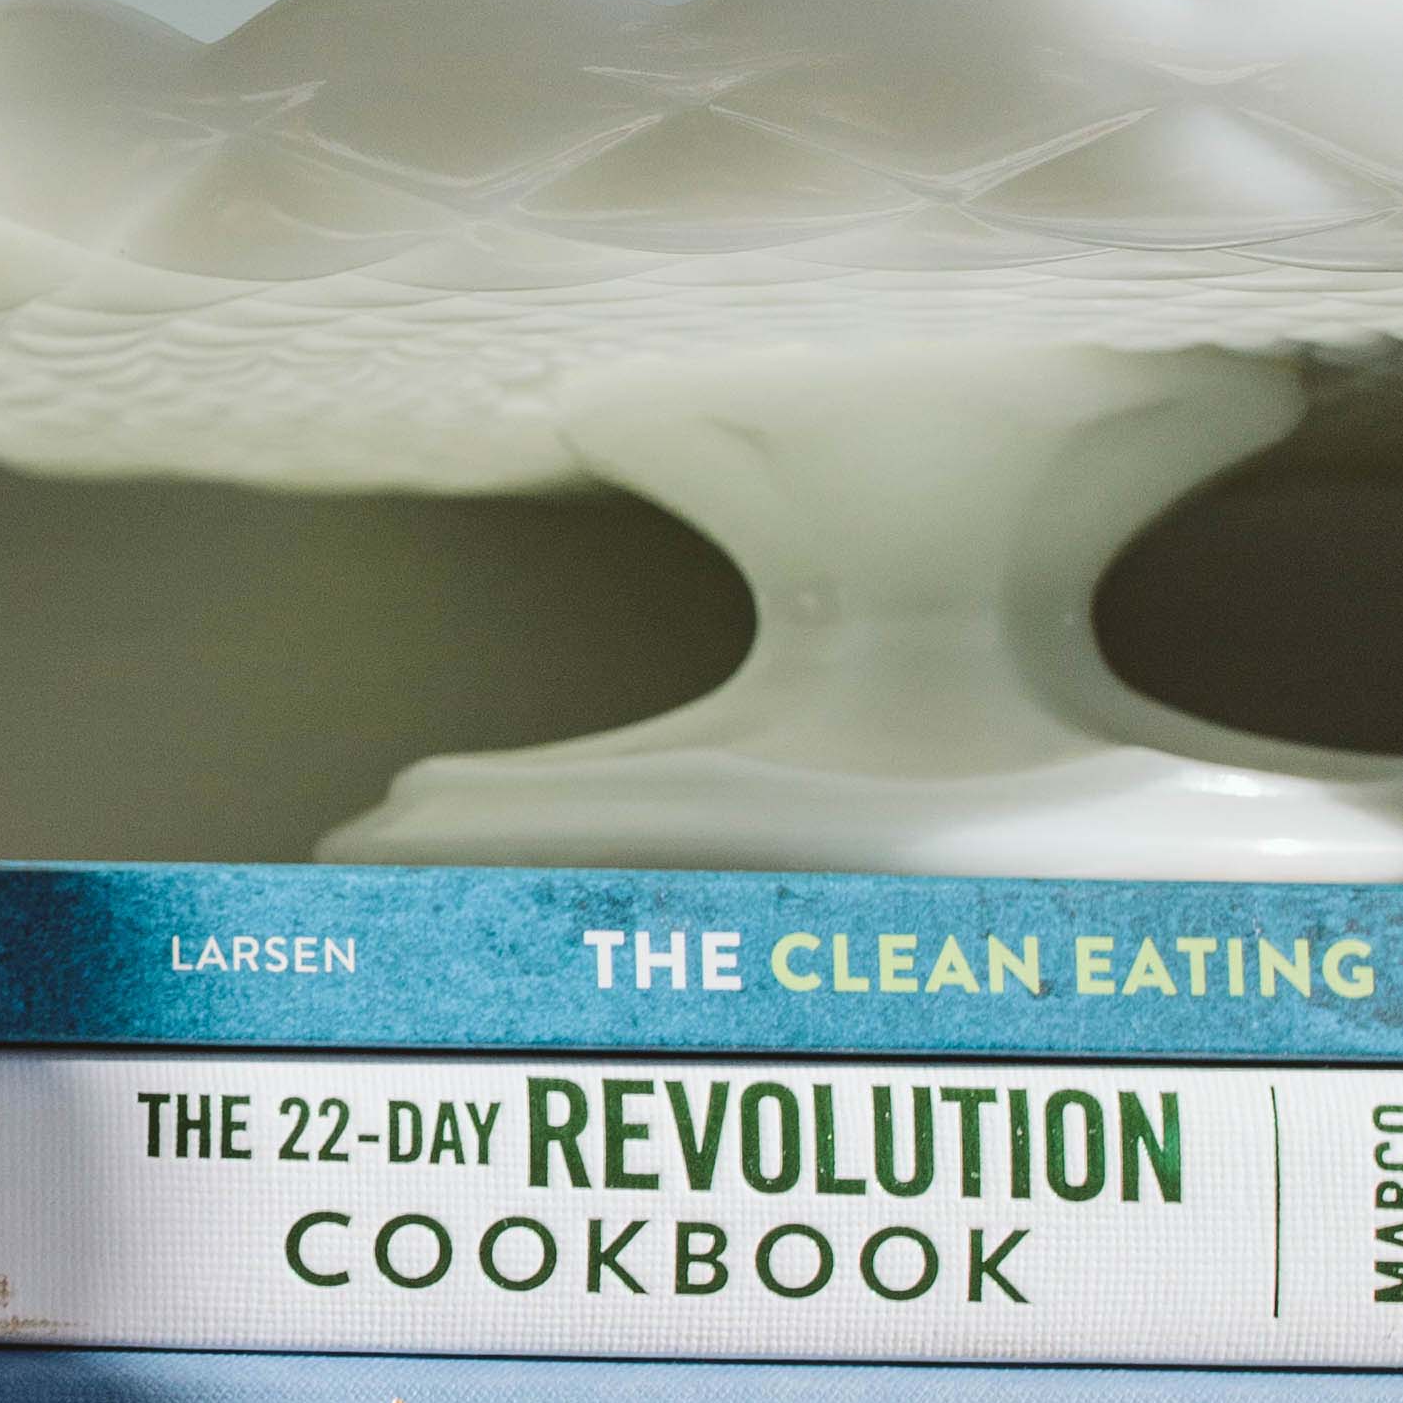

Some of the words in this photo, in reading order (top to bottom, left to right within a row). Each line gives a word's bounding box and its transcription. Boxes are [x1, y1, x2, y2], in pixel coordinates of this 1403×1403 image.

[171, 935, 356, 973] LARSEN
[584, 931, 742, 990] THE
[771, 933, 1042, 995] CLEAN
[1075, 936, 1376, 999] EATING
[137, 1091, 252, 1160] THE
[279, 1098, 500, 1165] 22-DAY
[527, 1077, 1182, 1203] REVOLUTION
[285, 1211, 1030, 1305] COOKBOOK
